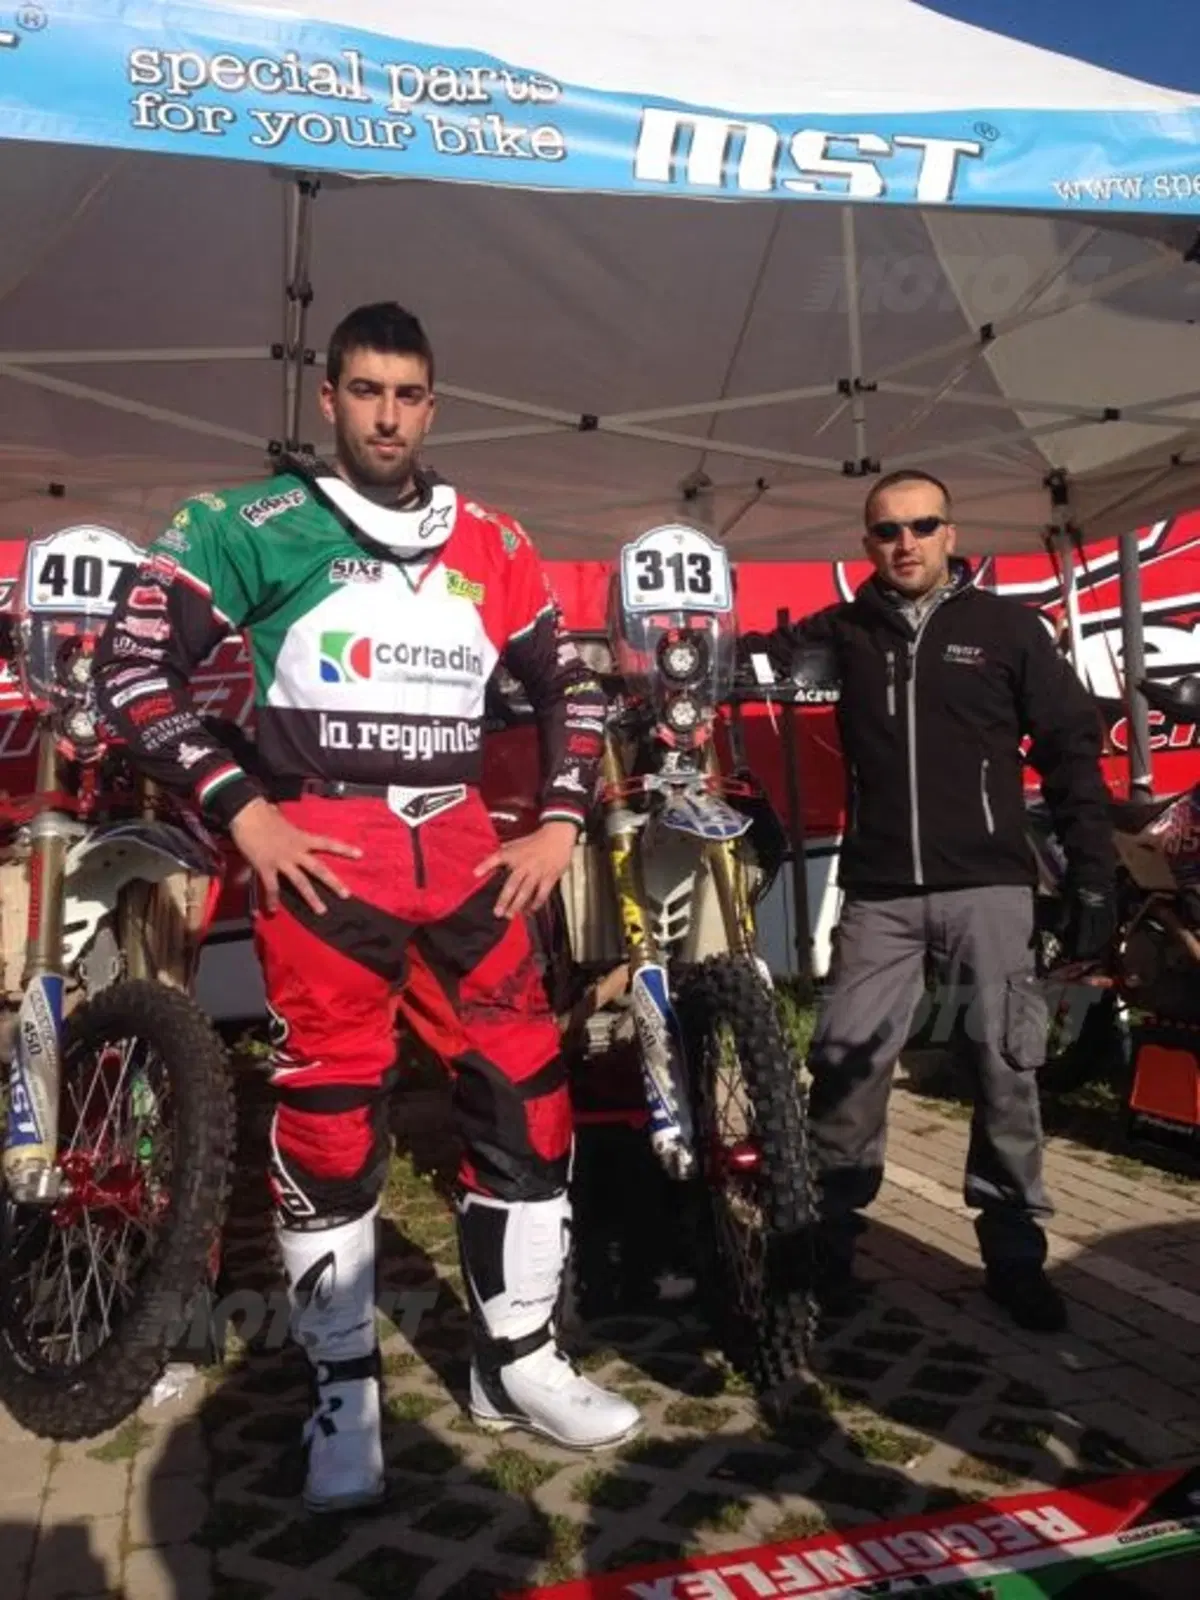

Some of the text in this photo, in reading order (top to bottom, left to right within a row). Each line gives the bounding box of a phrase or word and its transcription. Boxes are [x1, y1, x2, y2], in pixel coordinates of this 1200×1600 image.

[128, 45, 371, 101] special
[131, 91, 568, 160] for your bike
[38, 552, 137, 603] 407
[634, 549, 712, 595] 313
[23, 1020, 43, 1056] 450
[625, 1505, 1089, 1600] REGGINFLEX
